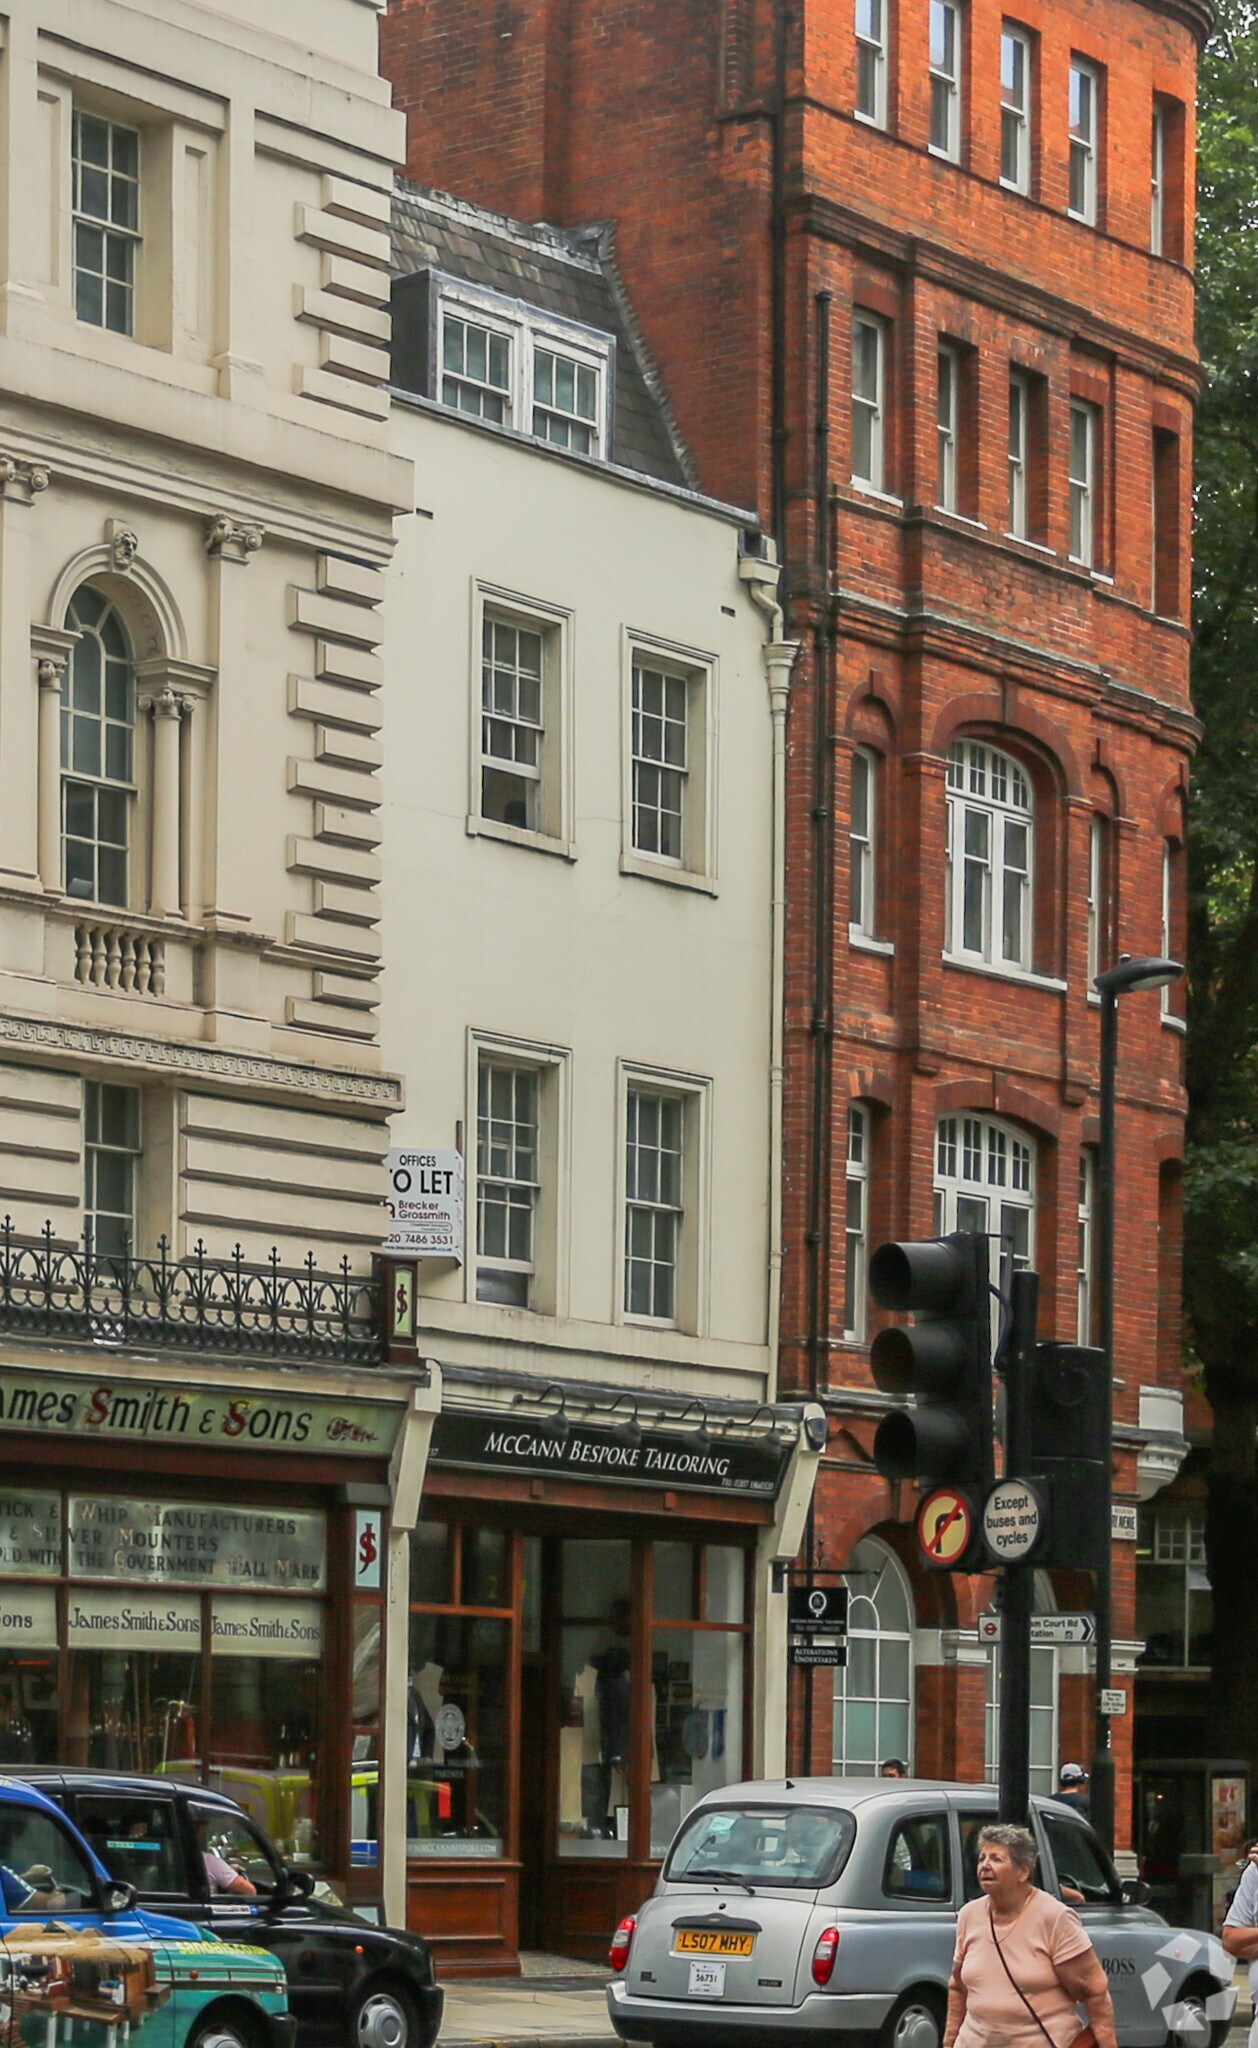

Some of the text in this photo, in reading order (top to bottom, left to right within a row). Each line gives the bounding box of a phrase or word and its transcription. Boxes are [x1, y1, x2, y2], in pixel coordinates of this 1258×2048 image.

[399, 1154, 437, 1167] OFFICES
[389, 1168, 454, 1194] O LET
[398, 1200, 439, 1210] Brecker
[398, 1209, 451, 1220] Grossmith
[405, 1234, 428, 1244] 7486
[430, 1235, 453, 1245] 3531
[0, 1386, 77, 1423] mes
[85, 1387, 191, 1433] Smith
[222, 1400, 313, 1441] Sons
[568, 1440, 640, 1466] BESPOKE
[644, 1447, 730, 1476] TAILORING
[994, 1495, 1029, 1511] Except
[79, 1502, 128, 1524] WHIP
[141, 1504, 297, 1535] MANUFACTURERS
[986, 1512, 1037, 1528] buses and
[119, 1527, 219, 1553] MOUNTERS
[996, 1531, 1029, 1547] cycles
[78, 1550, 104, 1568] THE
[114, 1550, 216, 1575] GOVERNMENT
[228, 1554, 268, 1577] HALL
[276, 1558, 320, 1580] MARK
[69, 1607, 120, 1629] James
[121, 1609, 157, 1631] Smith
[166, 1611, 200, 1633] Sons
[211, 1615, 248, 1637] James
[249, 1617, 284, 1638] Smith
[291, 1618, 322, 1640] Sons
[1043, 1619, 1066, 1628] Court
[1067, 1619, 1078, 1627] Rd
[794, 1648, 838, 1656] ALTERATIONS
[794, 1655, 838, 1663] UNDERTAKEN
[681, 1932, 718, 1949] LS07
[1101, 1957, 1136, 1976] BOSS
